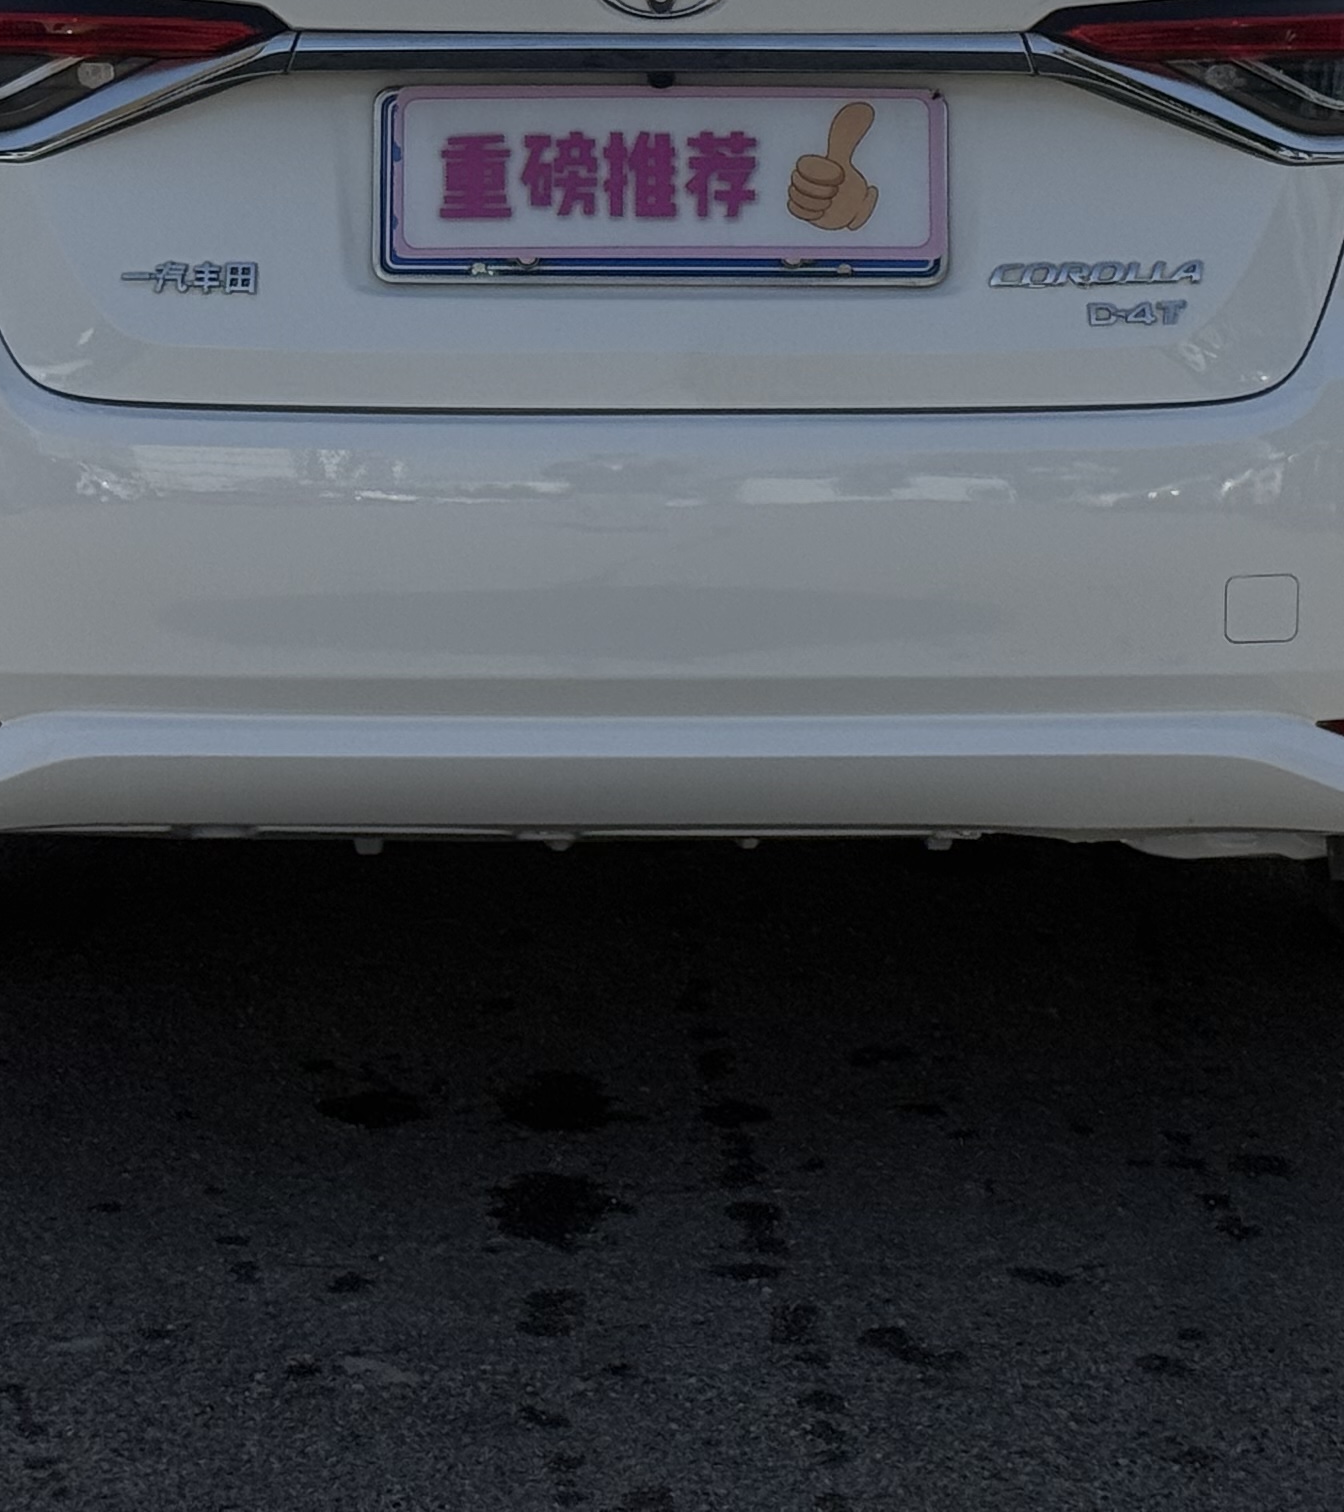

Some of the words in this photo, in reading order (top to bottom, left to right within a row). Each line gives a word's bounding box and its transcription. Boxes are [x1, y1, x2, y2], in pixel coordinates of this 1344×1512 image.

[439, 131, 758, 219] 重磅推荐
[120, 260, 259, 295] 一汽丰田
[988, 259, 1205, 288] COROLLA
[1086, 299, 1188, 327] D-4T
